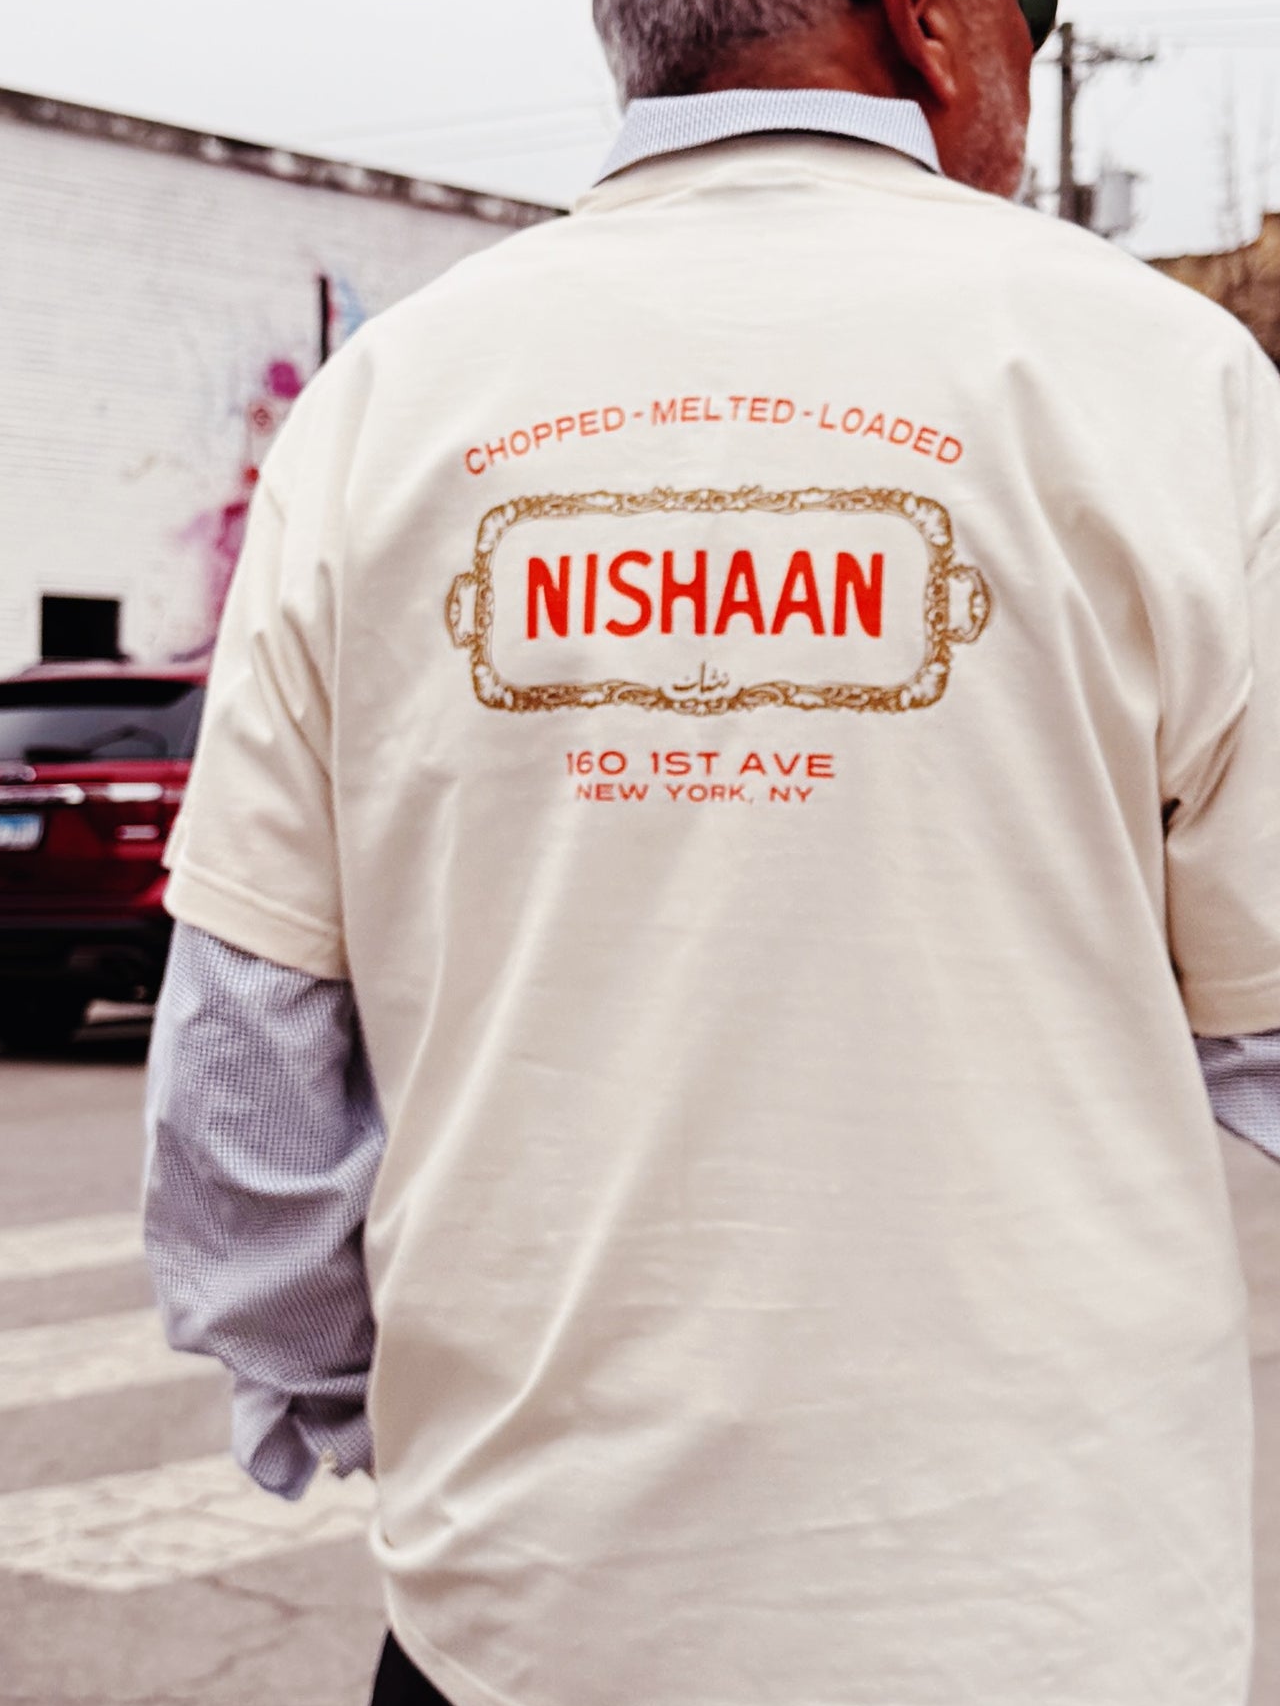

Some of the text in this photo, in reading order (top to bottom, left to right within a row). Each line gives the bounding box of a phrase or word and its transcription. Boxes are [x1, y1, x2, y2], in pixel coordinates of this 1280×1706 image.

[464, 406, 625, 476] CHOPPED
[650, 395, 795, 425] MELTED
[819, 403, 963, 466] LOADED
[524, 548, 886, 641] NISHAAN
[566, 750, 835, 779] 160 1ST AVE
[575, 783, 649, 803] NEW
[768, 785, 813, 803] NY
